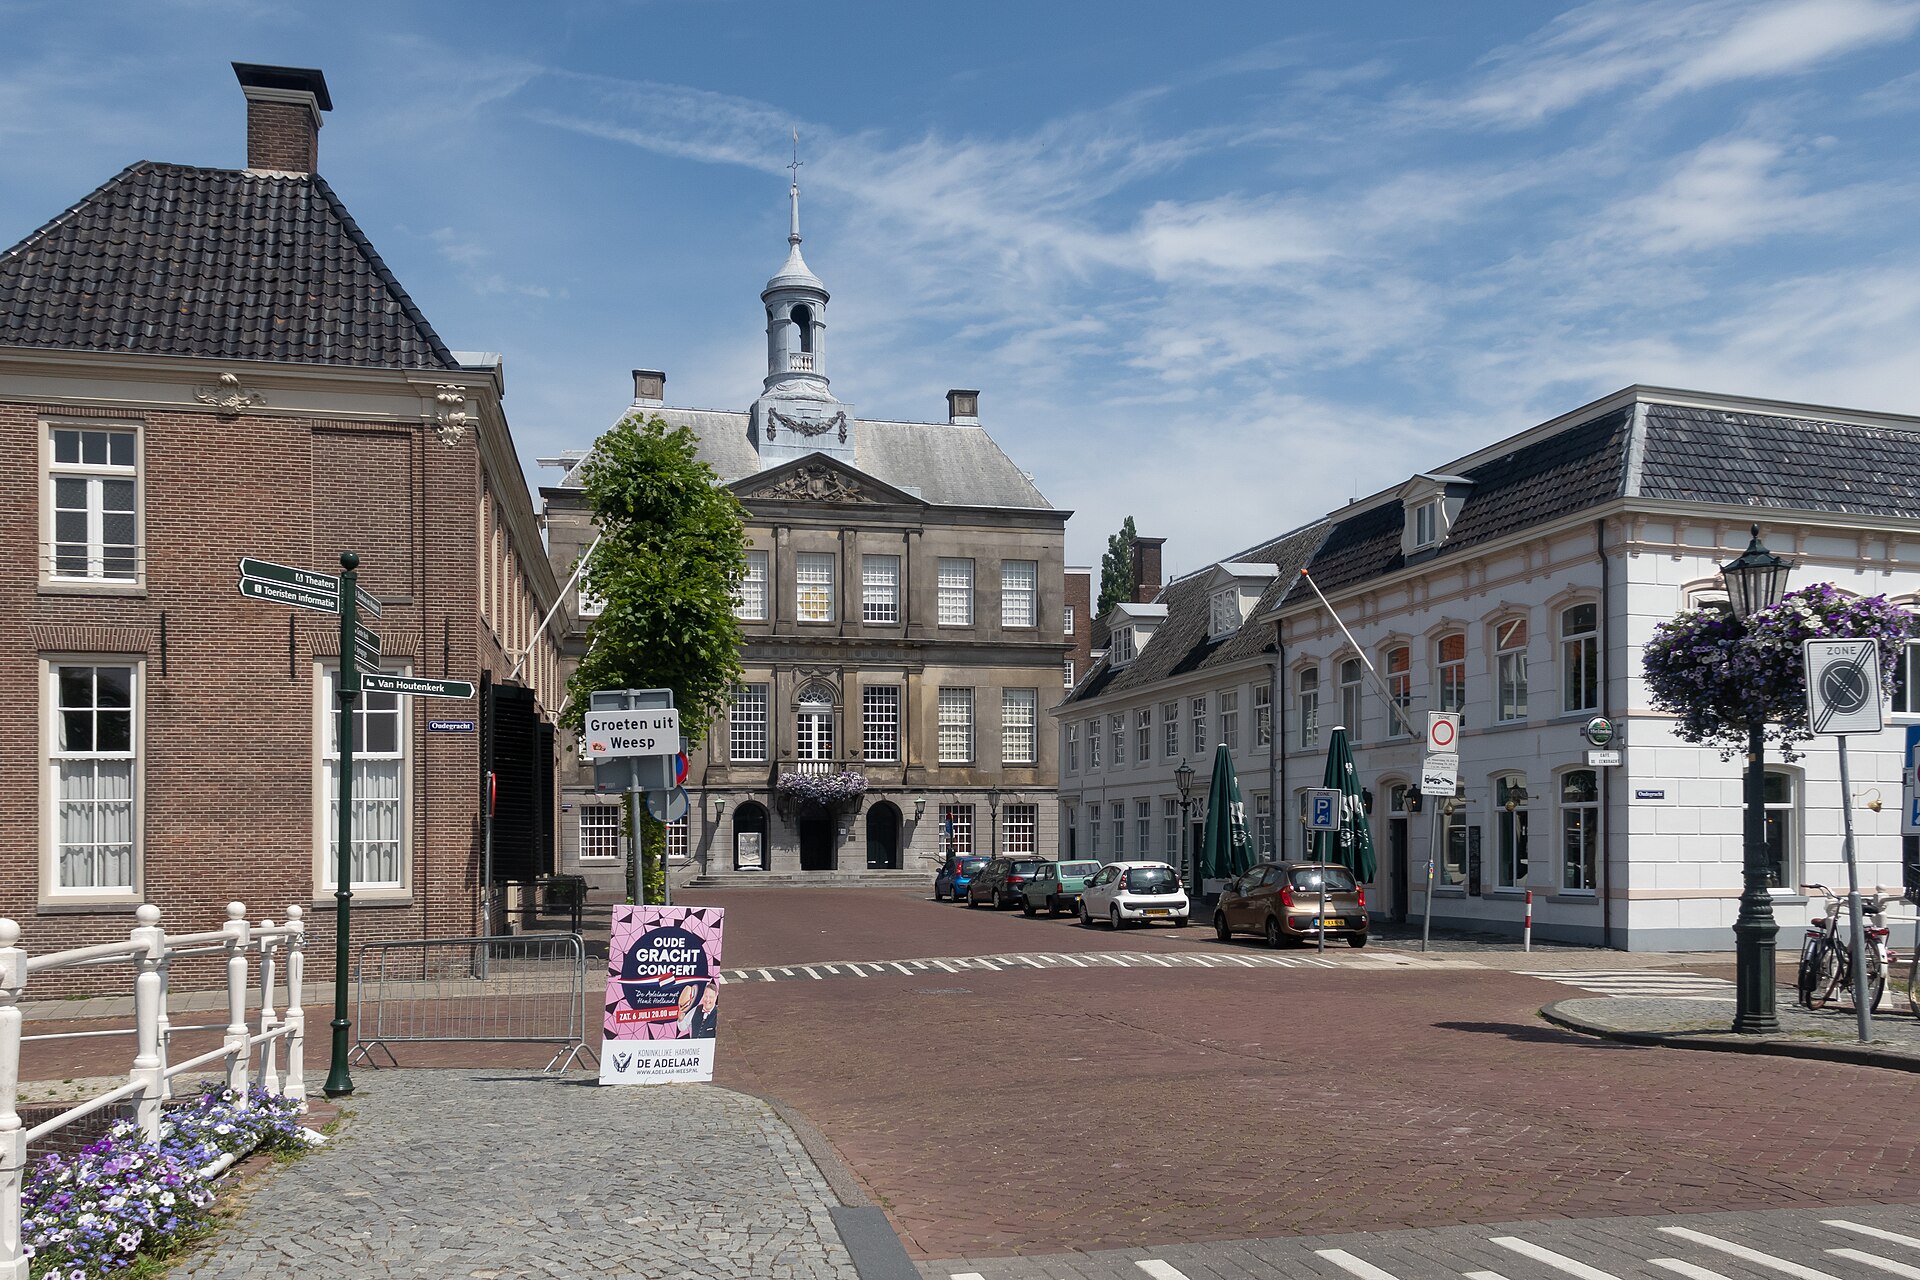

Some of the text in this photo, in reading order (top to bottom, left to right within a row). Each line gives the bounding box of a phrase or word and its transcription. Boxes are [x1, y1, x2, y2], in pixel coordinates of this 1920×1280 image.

[305, 576, 335, 589] Theaters
[264, 586, 335, 608] Toeristen informatie
[1826, 646, 1856, 655] ZONE
[378, 680, 444, 692] Van Houtenkerk
[591, 717, 674, 731] Groeten uit
[610, 736, 655, 749] Weesp
[1317, 800, 1328, 814] P
[653, 937, 685, 948] OUDE
[636, 949, 700, 963] GRACHT
[637, 965, 697, 976] CONCERT
[652, 1010, 668, 1018] 20.00
[637, 1058, 700, 1068] DE ADELAAR
